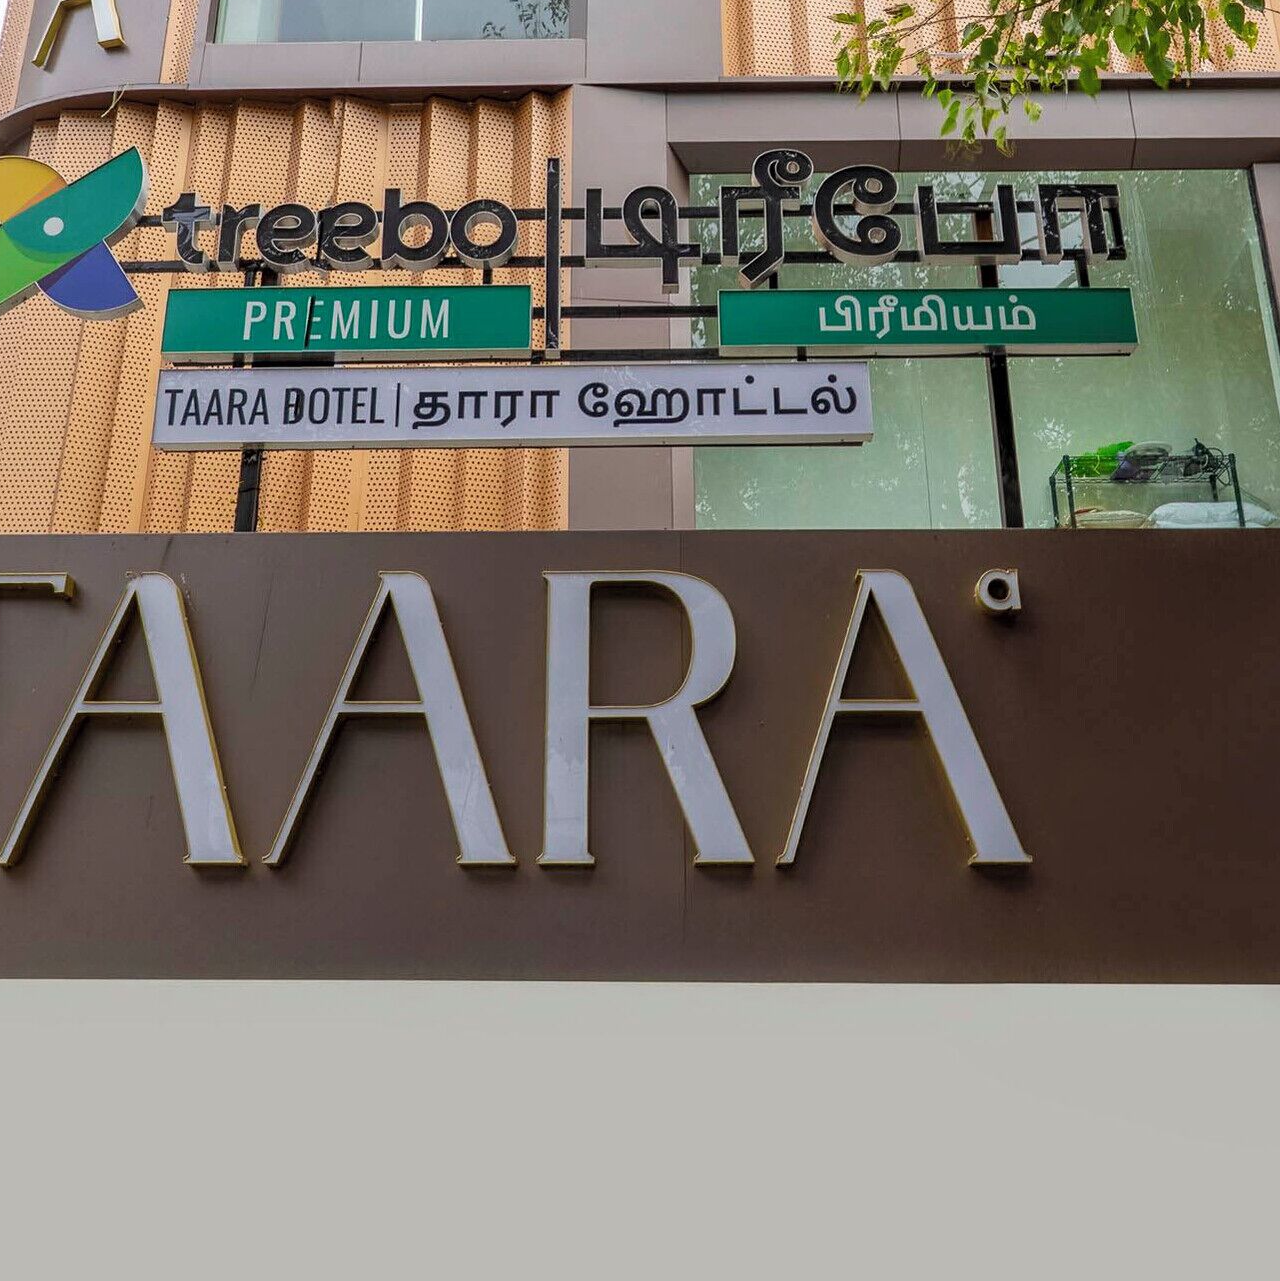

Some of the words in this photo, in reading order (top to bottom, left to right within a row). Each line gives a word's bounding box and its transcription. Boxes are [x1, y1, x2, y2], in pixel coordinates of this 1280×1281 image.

[162, 187, 520, 273] treebo
[243, 298, 450, 341] PREMIUM
[818, 294, 1037, 340] பிரீமியம்
[164, 387, 270, 426] TAARA
[412, 390, 560, 430] தாரா
[577, 374, 858, 428] ஹோட்டல்
